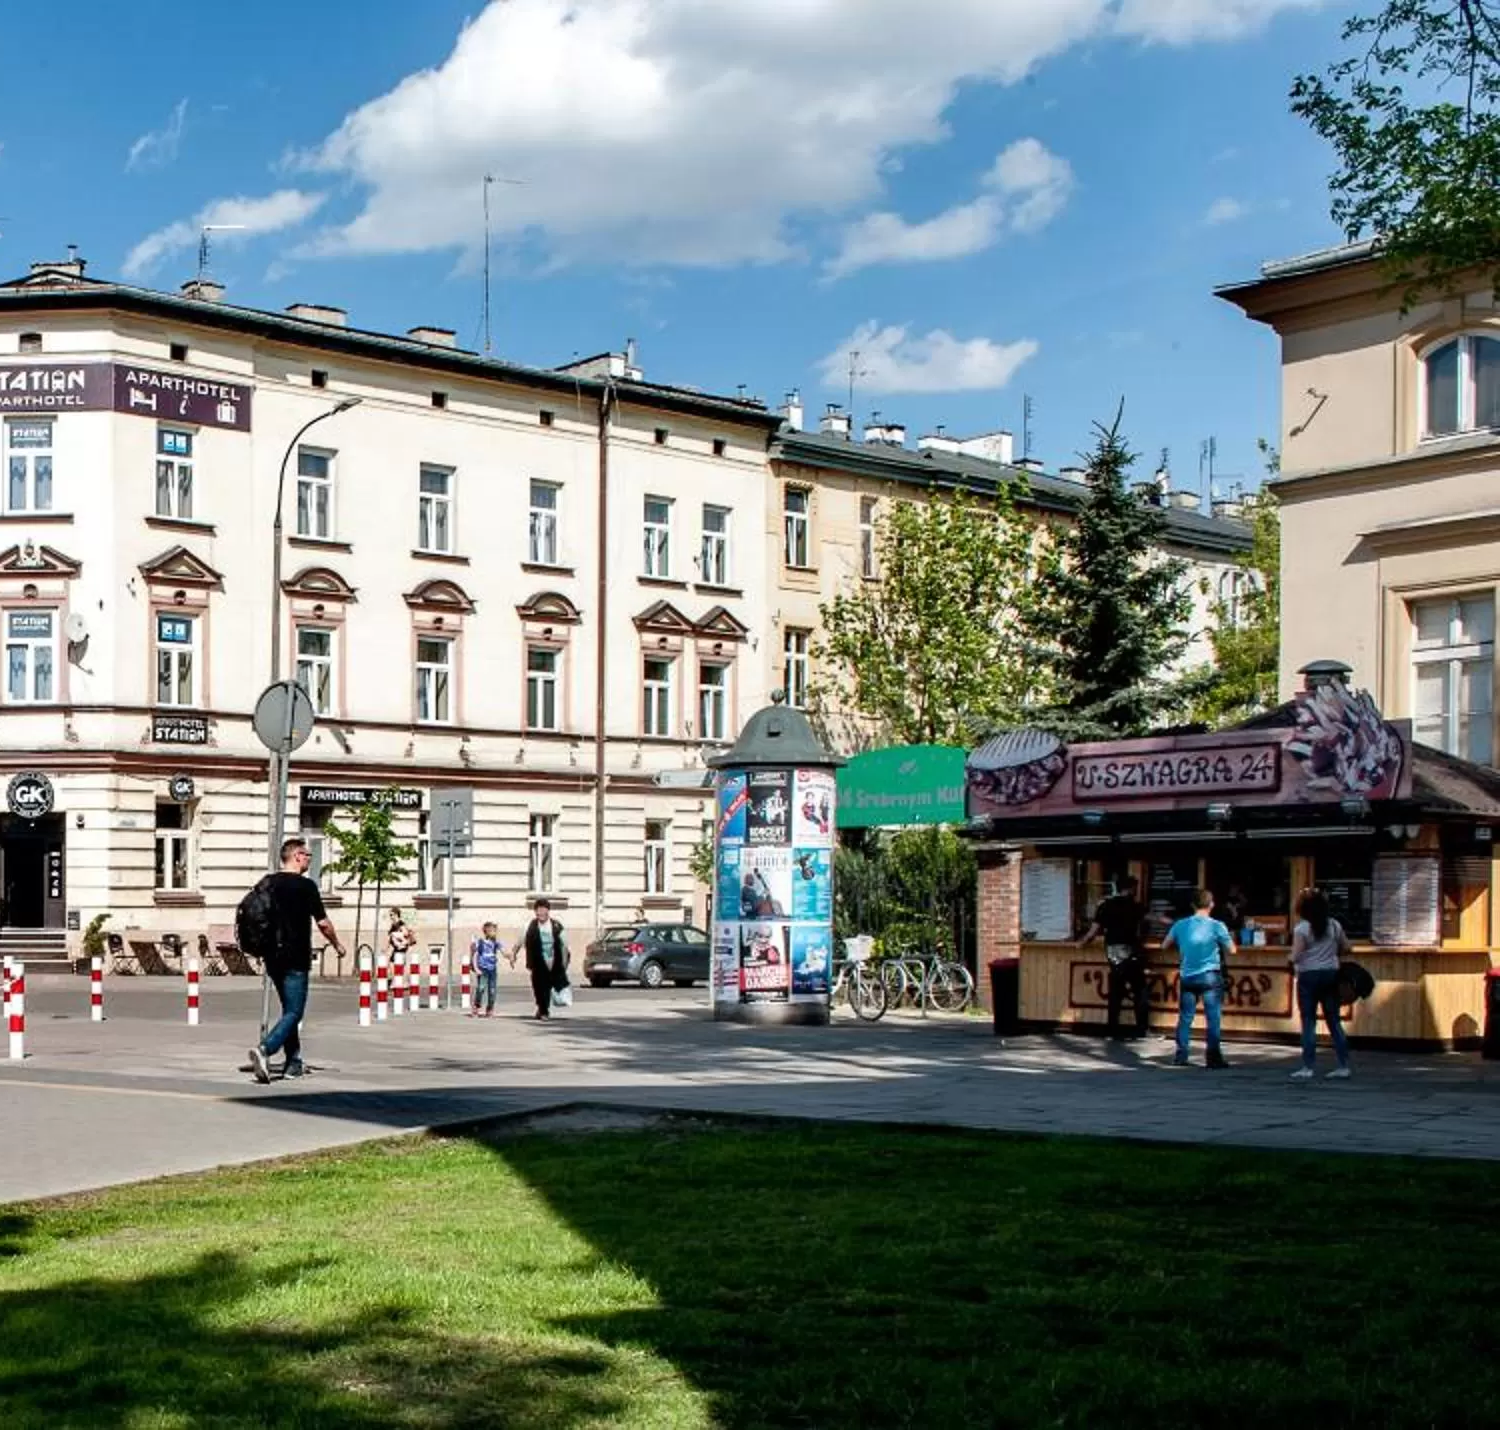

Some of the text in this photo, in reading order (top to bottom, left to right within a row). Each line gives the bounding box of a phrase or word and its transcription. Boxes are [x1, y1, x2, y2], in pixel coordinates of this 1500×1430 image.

[126, 371, 241, 401] APARTHOTEL
[156, 728, 205, 741] STATION
[1238, 754, 1274, 782] 24
[16, 785, 46, 802] GK
[307, 789, 366, 802] APARTHOTEL
